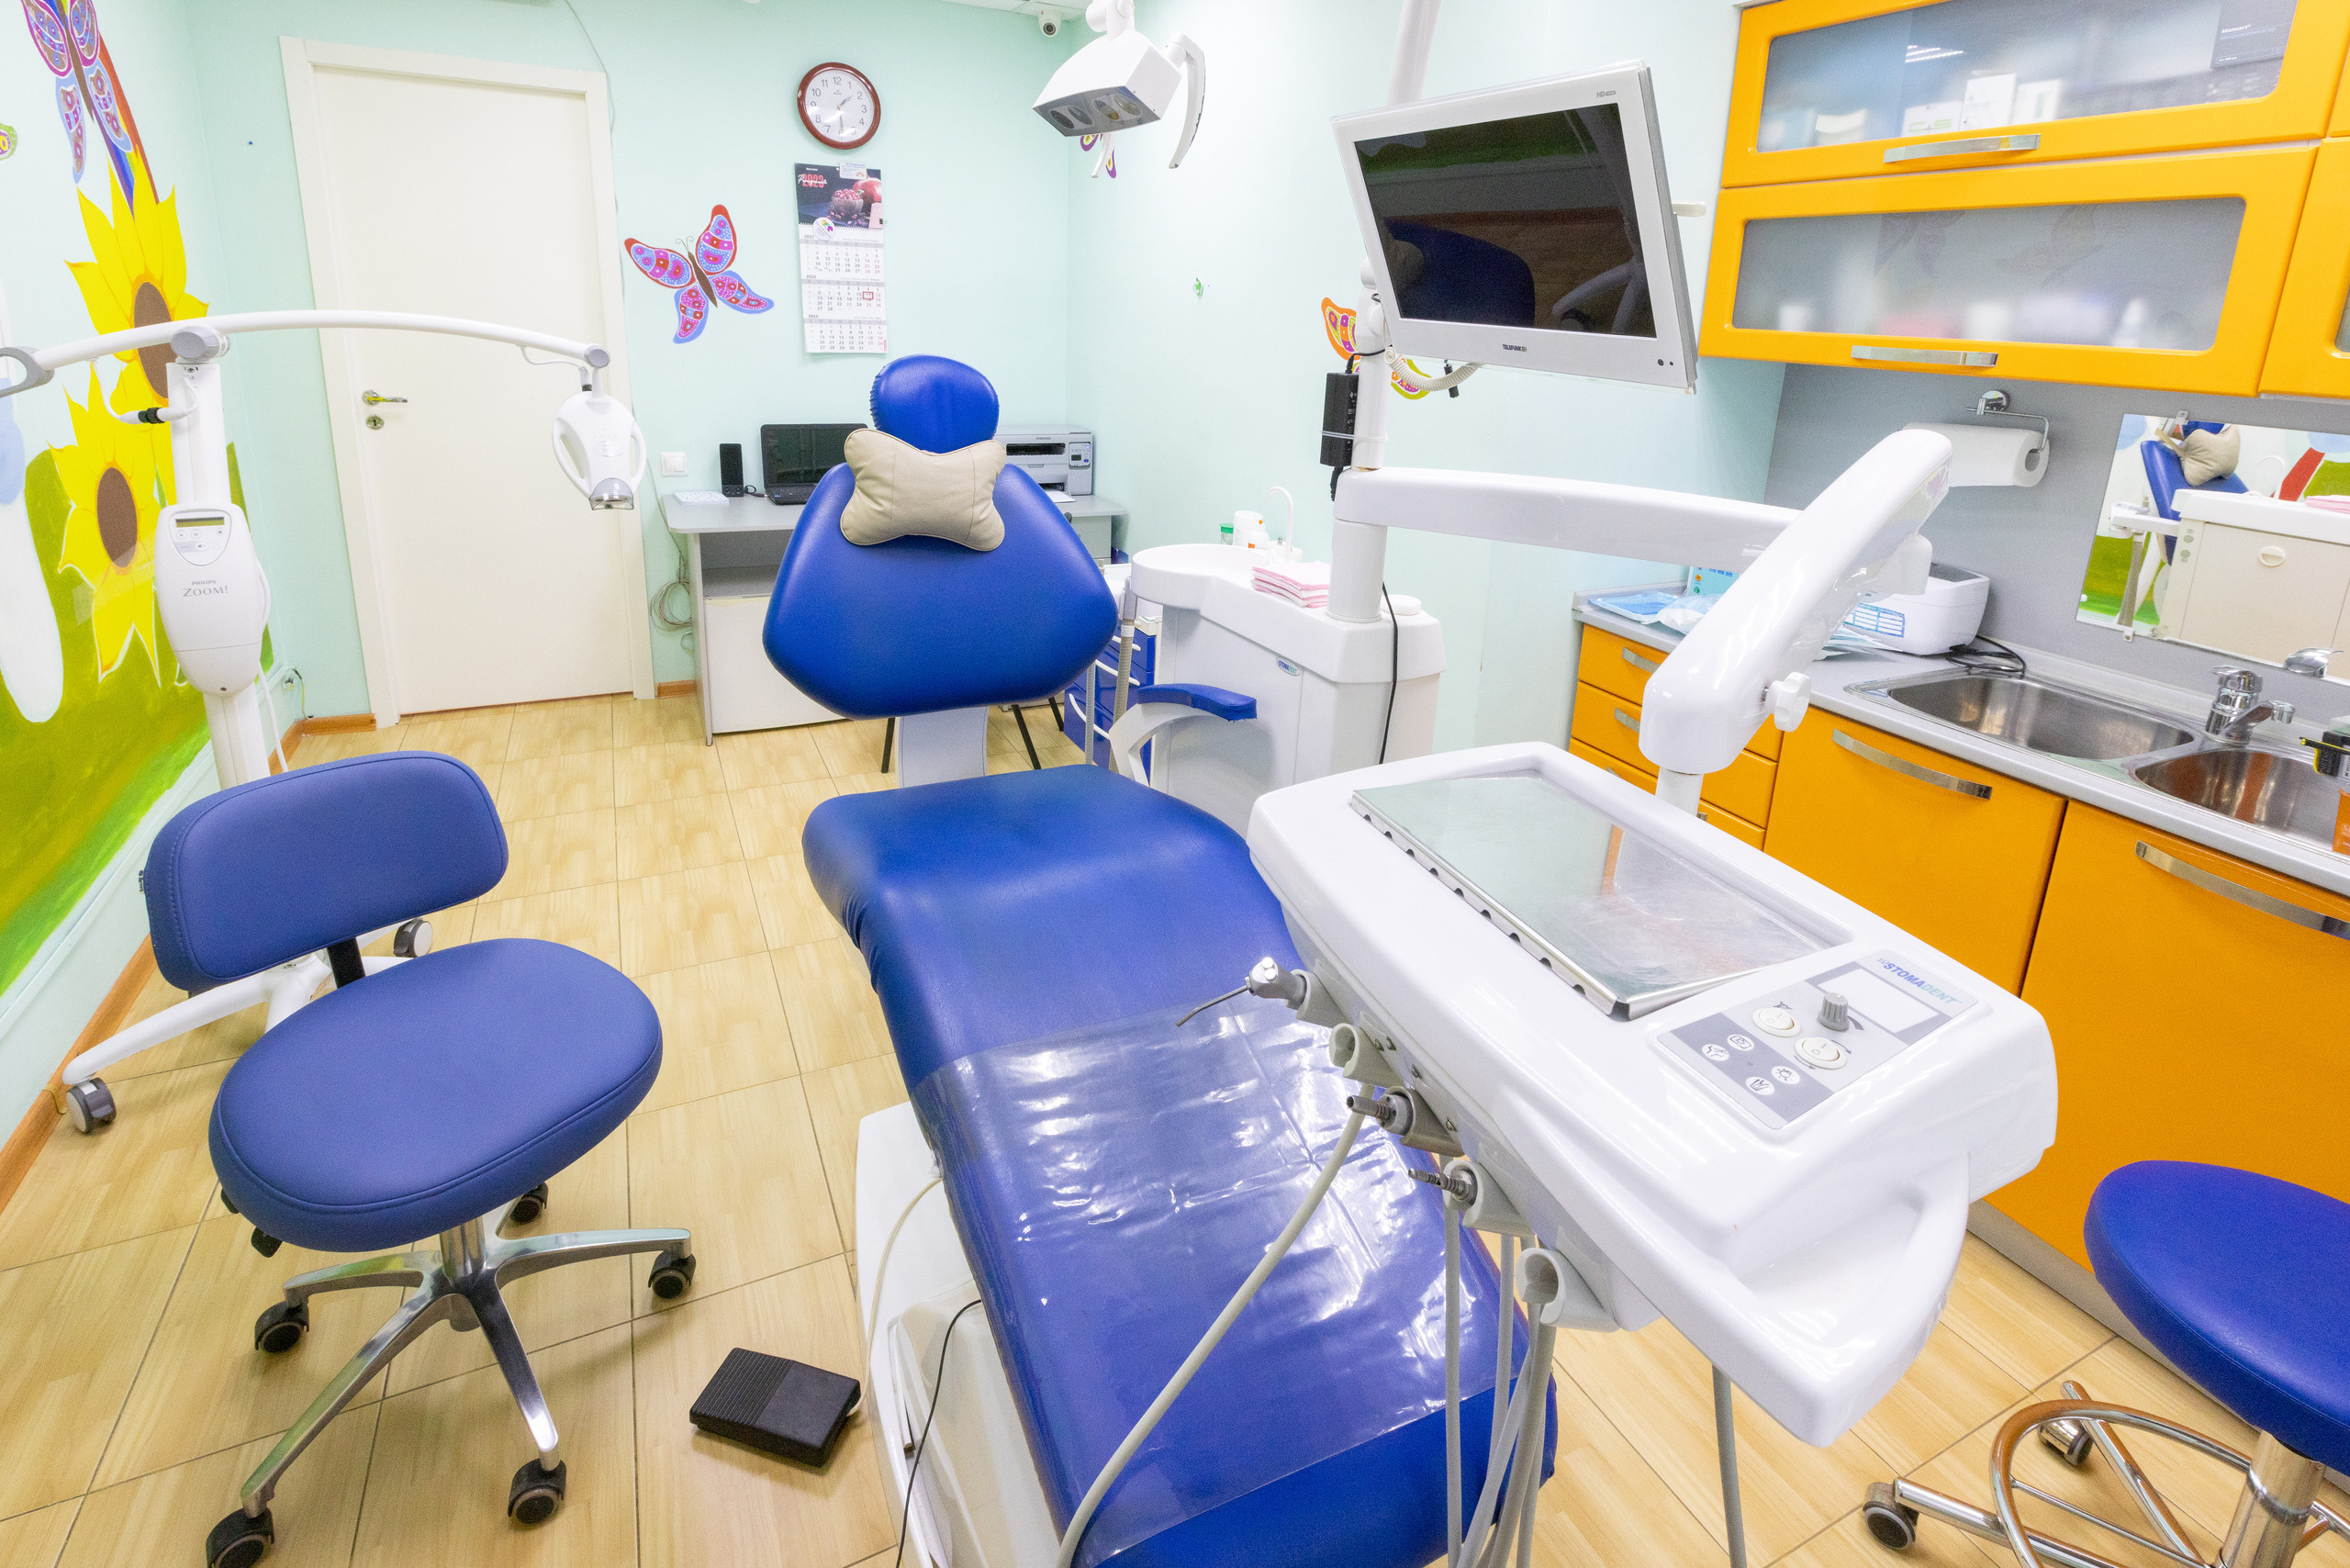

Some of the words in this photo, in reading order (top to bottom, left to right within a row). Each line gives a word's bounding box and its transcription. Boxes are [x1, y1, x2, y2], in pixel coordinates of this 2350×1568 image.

[812, 88, 821, 97] 10
[857, 91, 863, 100] 2
[861, 105, 867, 113] 3
[816, 115, 821, 123] 8
[183, 585, 228, 597] ZOOM!
[1883, 962, 1959, 1004] STOMADENT
